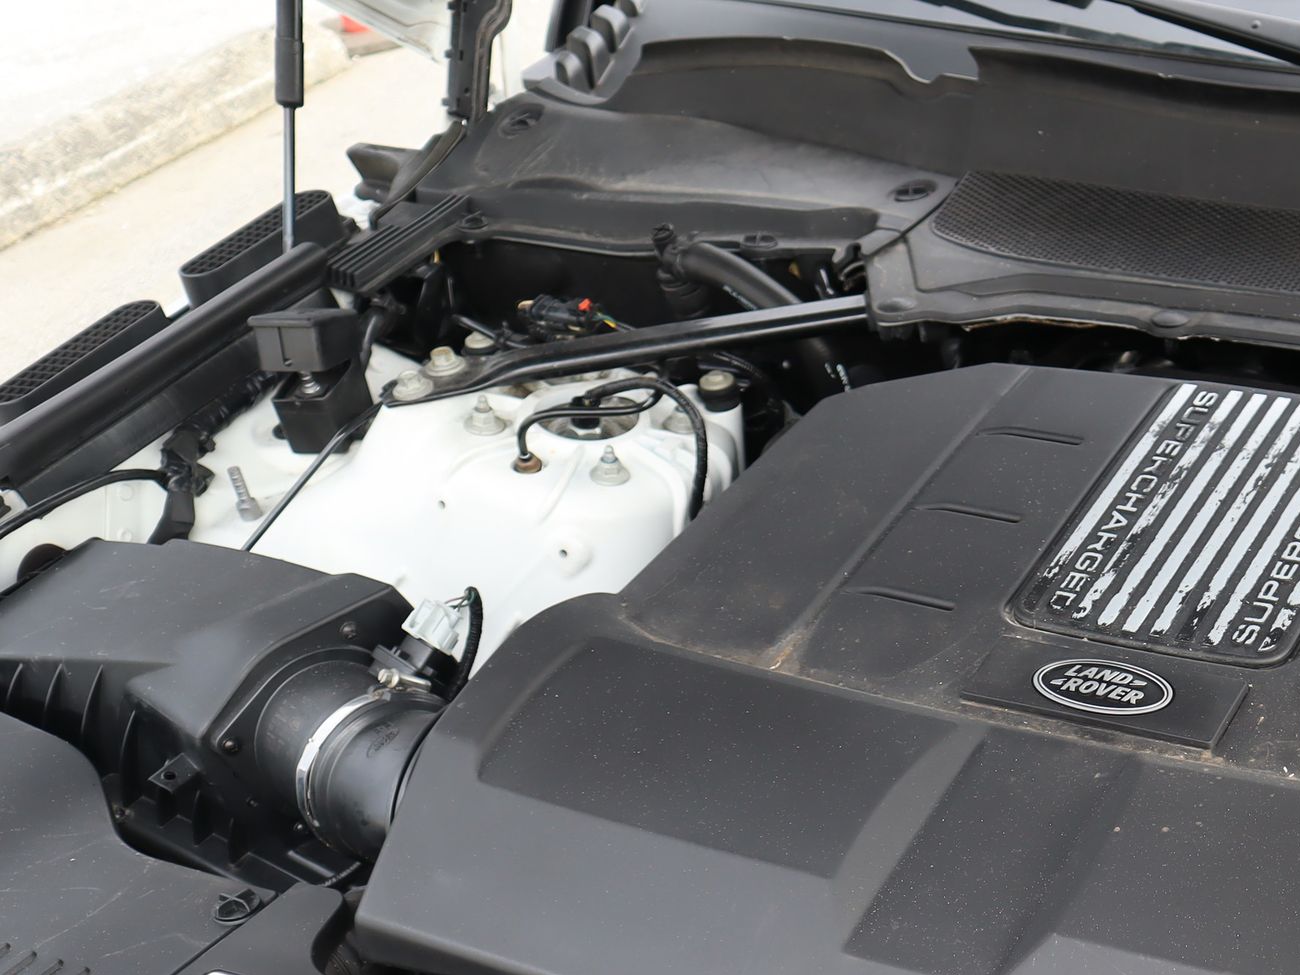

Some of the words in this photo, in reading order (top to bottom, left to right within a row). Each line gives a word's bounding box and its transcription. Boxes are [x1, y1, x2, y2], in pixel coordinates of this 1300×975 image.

[1049, 390, 1218, 610] SUPERCHARGED
[1064, 664, 1133, 684] LAND
[1060, 677, 1145, 705] ROVER
